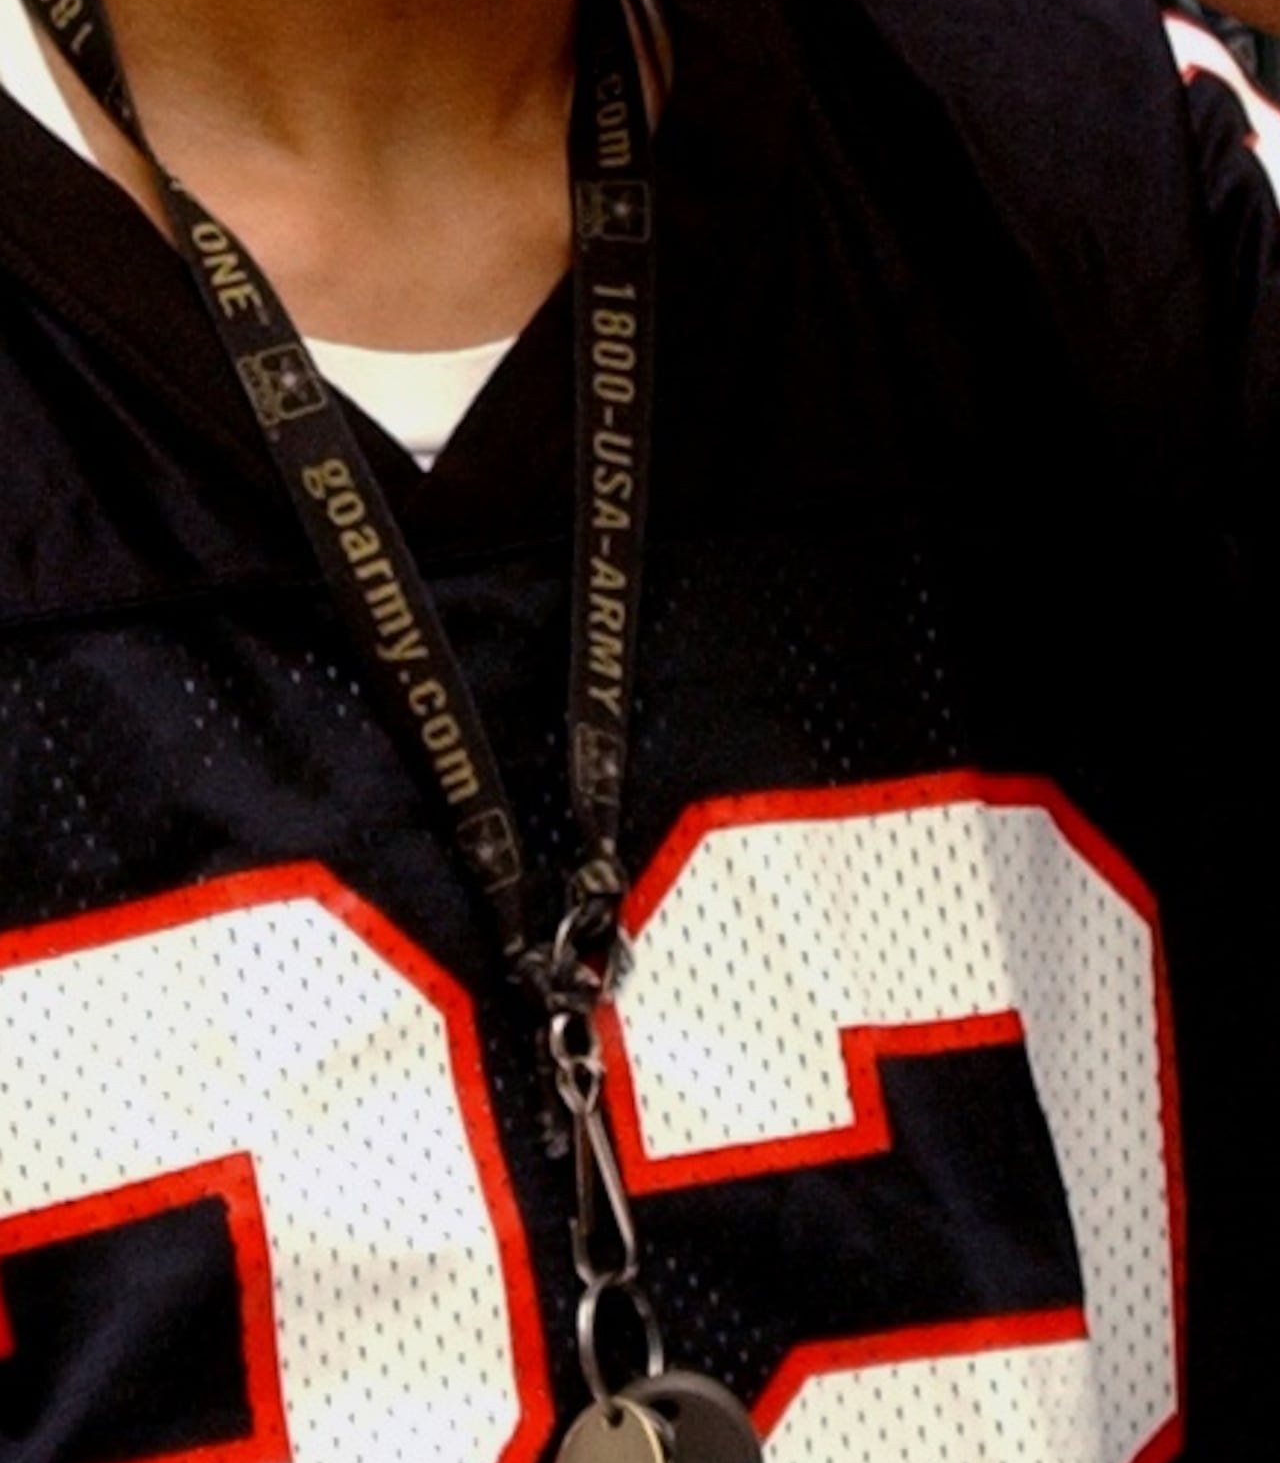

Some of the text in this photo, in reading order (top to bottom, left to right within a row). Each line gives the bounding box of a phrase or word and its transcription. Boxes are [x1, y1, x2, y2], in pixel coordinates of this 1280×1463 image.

[191, 223, 259, 320] ONE
[301, 457, 481, 803] goarmy.com
[586, 282, 636, 717] 1800-USA-ARMY
